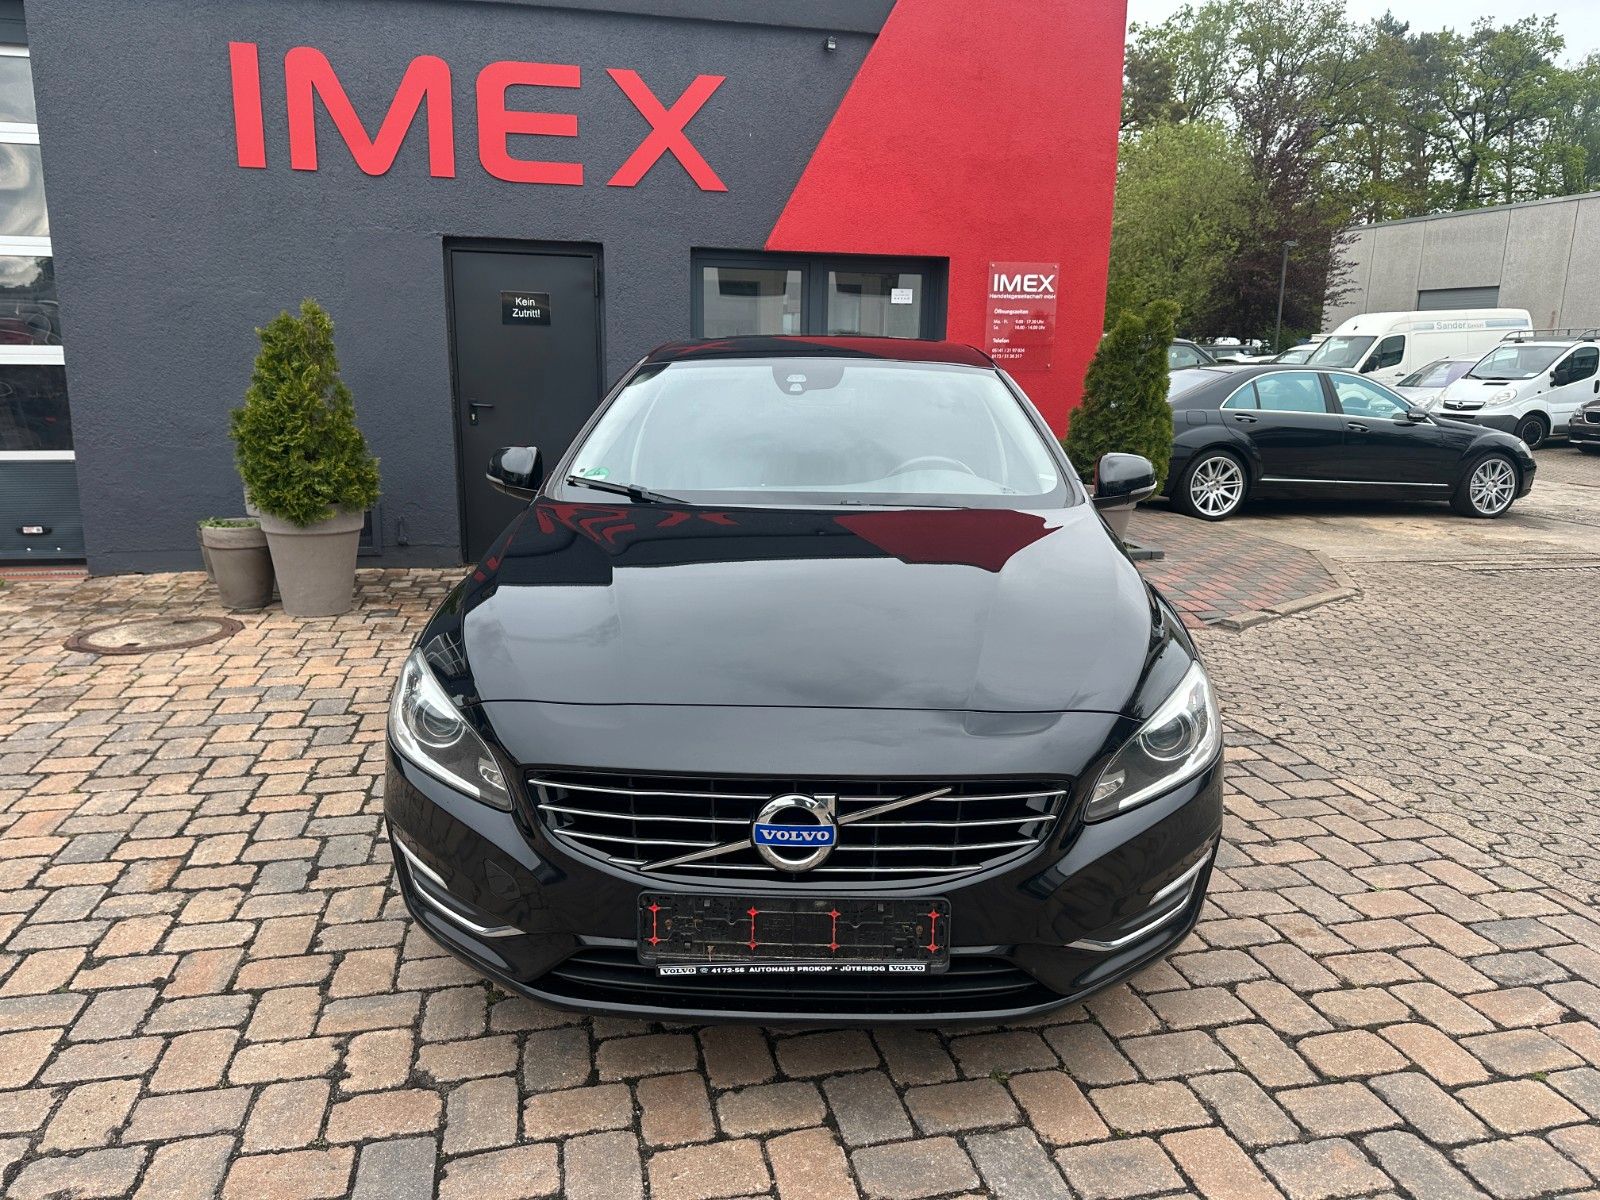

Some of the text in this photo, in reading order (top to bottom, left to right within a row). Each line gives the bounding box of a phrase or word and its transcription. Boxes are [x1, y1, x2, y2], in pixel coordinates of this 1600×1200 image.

[229, 41, 729, 192] IMEX
[993, 273, 1055, 292] IMEX
[515, 297, 536, 306] Kein
[512, 308, 541, 318] Zutritt!
[1436, 321, 1466, 330] Sander
[760, 828, 830, 841] VOLVO
